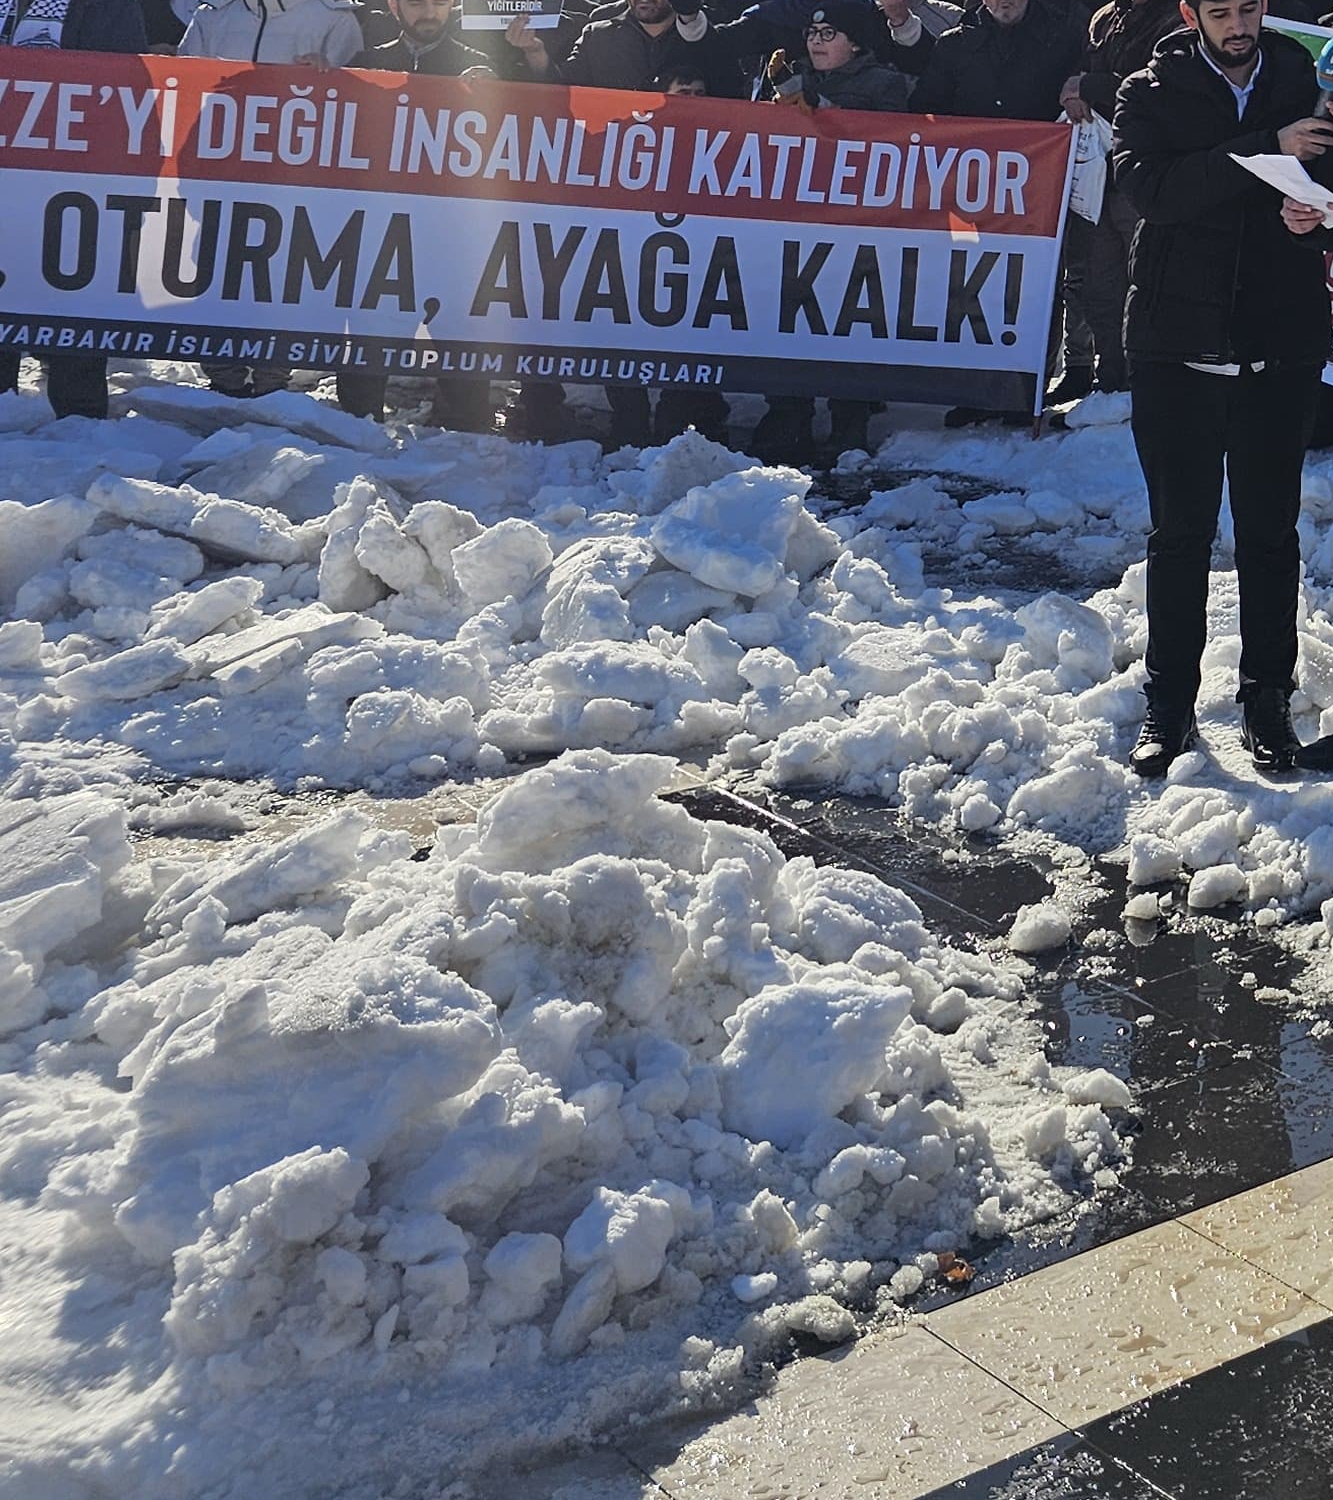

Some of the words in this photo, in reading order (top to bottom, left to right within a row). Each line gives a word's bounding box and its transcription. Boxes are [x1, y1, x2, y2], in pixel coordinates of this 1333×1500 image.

[197, 84, 370, 170] DEĞİL
[389, 94, 675, 193] İNSANLIĞI
[688, 129, 1029, 216] KATLEDİYOR
[40, 191, 442, 326] OTURMA,
[469, 210, 749, 331] AYAĞA
[777, 240, 1026, 346] KALK!
[0, 323, 155, 353] YARBAKIR
[165, 329, 276, 362] İSLAMİ
[287, 339, 368, 368] SİVİL
[381, 347, 504, 374] TOPLUM
[515, 354, 726, 386] KURULUŞLARI
